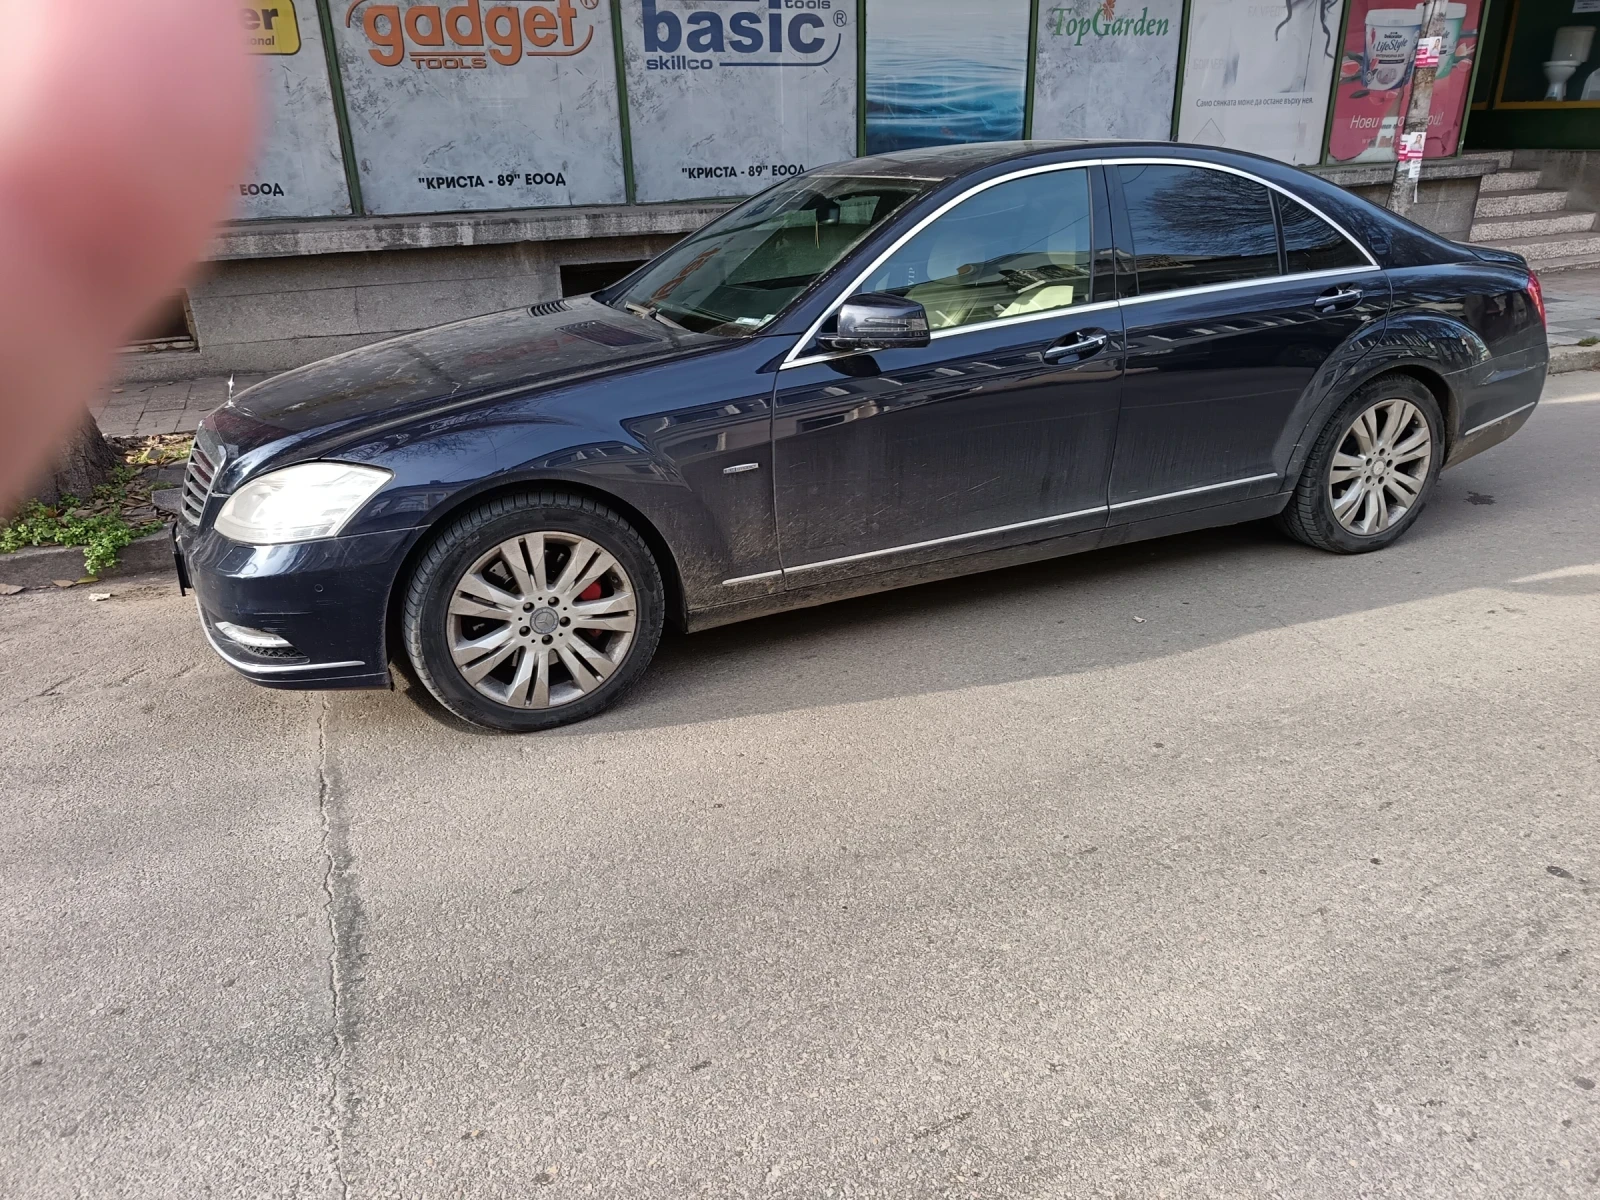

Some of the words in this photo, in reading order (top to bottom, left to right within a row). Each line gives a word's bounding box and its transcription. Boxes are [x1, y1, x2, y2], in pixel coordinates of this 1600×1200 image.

[785, 0, 831, 9] tools
[641, 0, 825, 54] basic
[1051, 6, 1169, 46] TopGarden
[363, 0, 577, 67] gadget
[1376, 38, 1408, 52] LifeStyle
[410, 58, 487, 69] TOOLS
[646, 55, 713, 70] skillco
[1196, 98, 1212, 107] Само
[1213, 98, 1237, 107] сянката
[1237, 98, 1254, 106] може
[1283, 97, 1301, 106] върху
[1350, 115, 1380, 129] Нови
[682, 166, 738, 179] "КРИСТА
[748, 165, 768, 177] 89"
[418, 175, 484, 189] "КРИСТА
[497, 173, 521, 187] 89"
[525, 172, 566, 187] ЕООД
[239, 183, 285, 196] ЕООД
